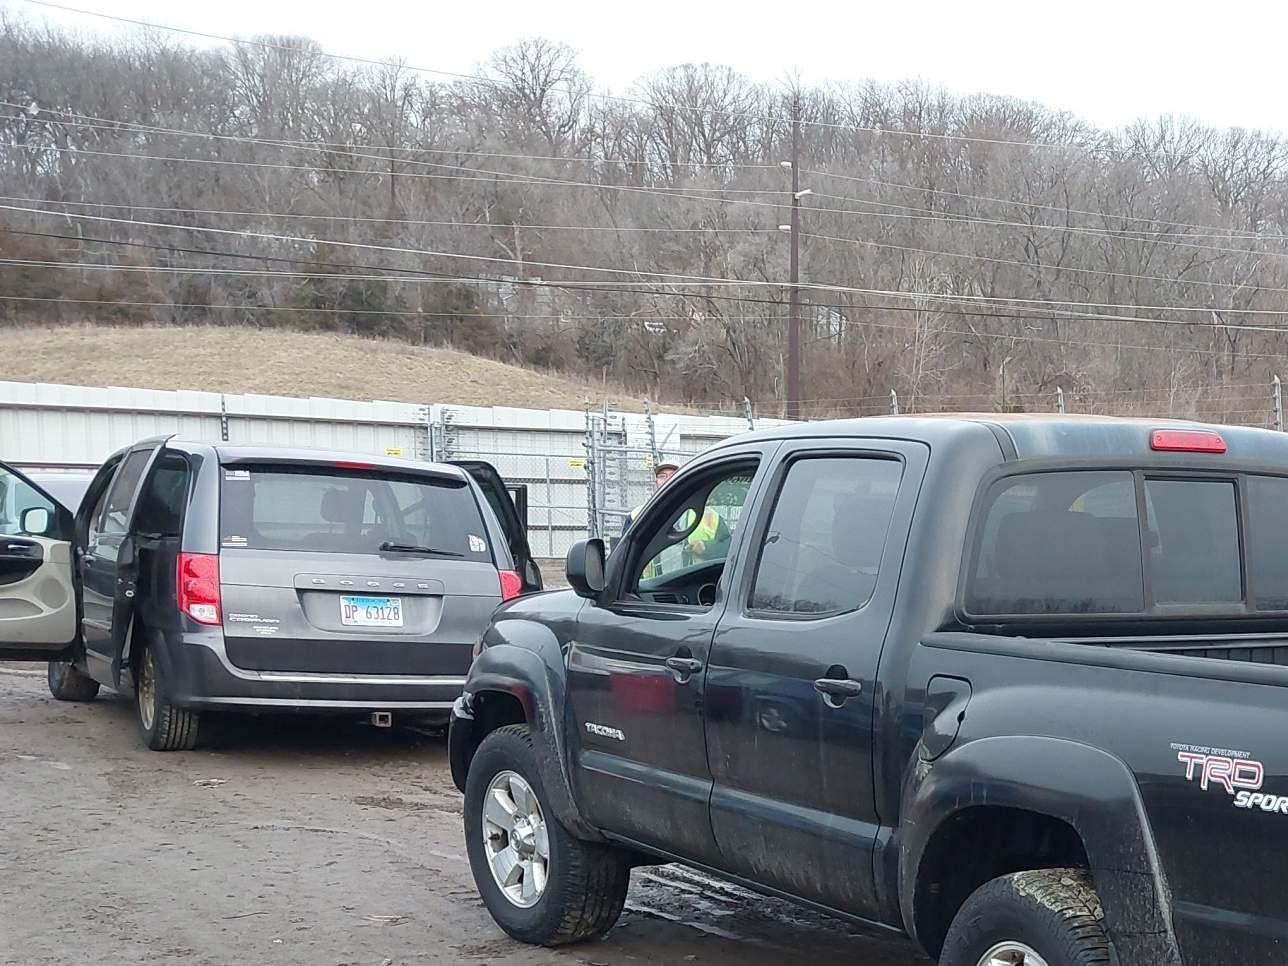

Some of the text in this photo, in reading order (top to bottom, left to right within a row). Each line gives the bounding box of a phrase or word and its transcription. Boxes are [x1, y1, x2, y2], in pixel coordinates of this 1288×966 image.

[311, 578, 430, 590] DODGE
[344, 604, 400, 621] DP 63128
[584, 721, 625, 741] TACOMA
[1177, 751, 1264, 795] TRD
